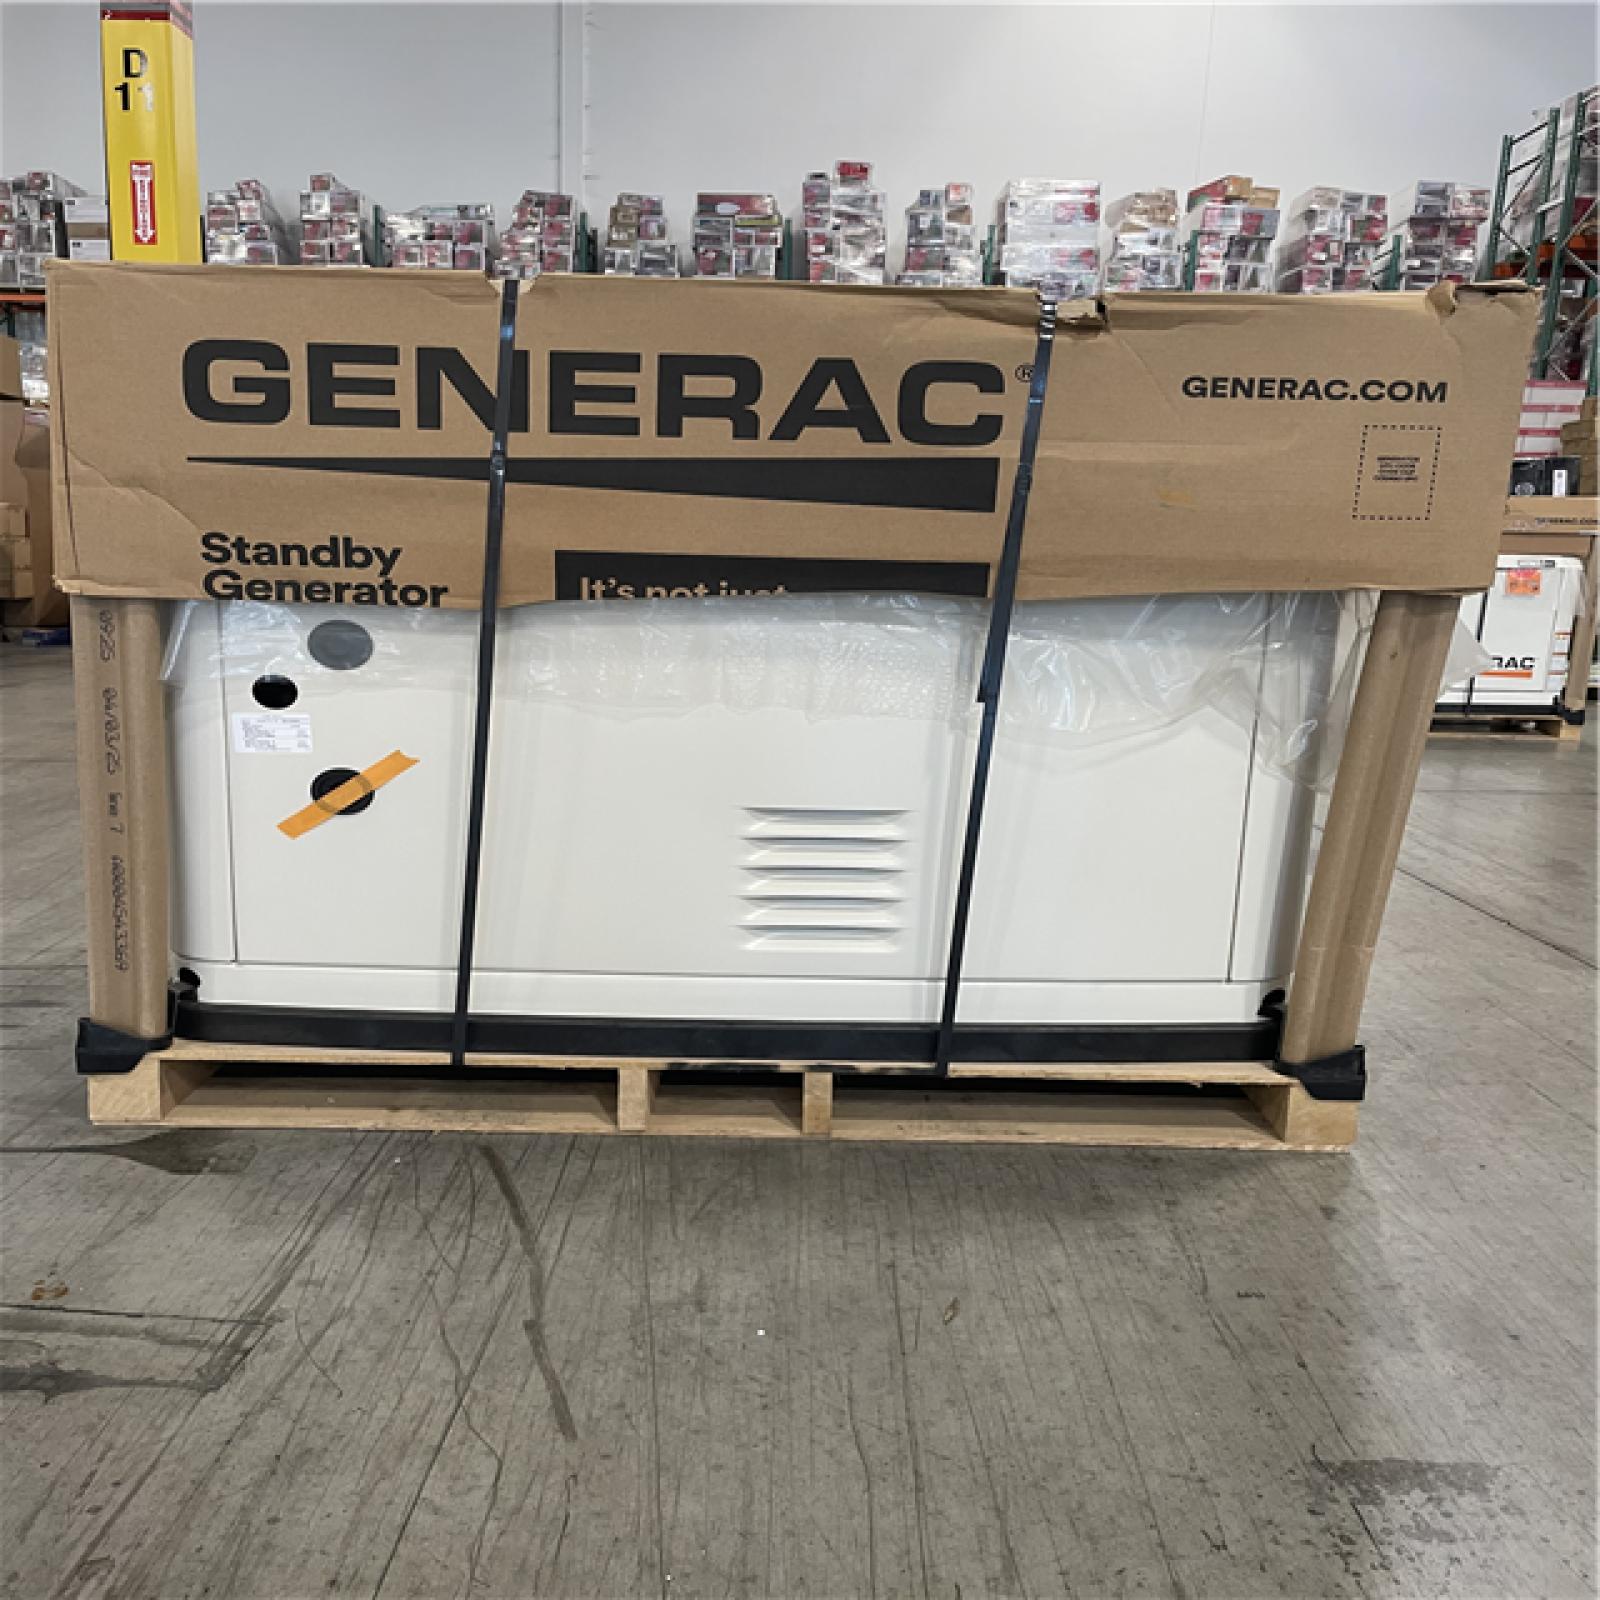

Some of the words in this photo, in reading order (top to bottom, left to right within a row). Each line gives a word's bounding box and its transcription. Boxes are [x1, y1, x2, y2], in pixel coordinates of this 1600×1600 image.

[123, 47, 147, 78] D
[182, 339, 1005, 446] GENERAC
[1182, 375, 1448, 403] GENERAC.COM
[201, 532, 402, 577] Standby
[203, 569, 448, 608] Generator
